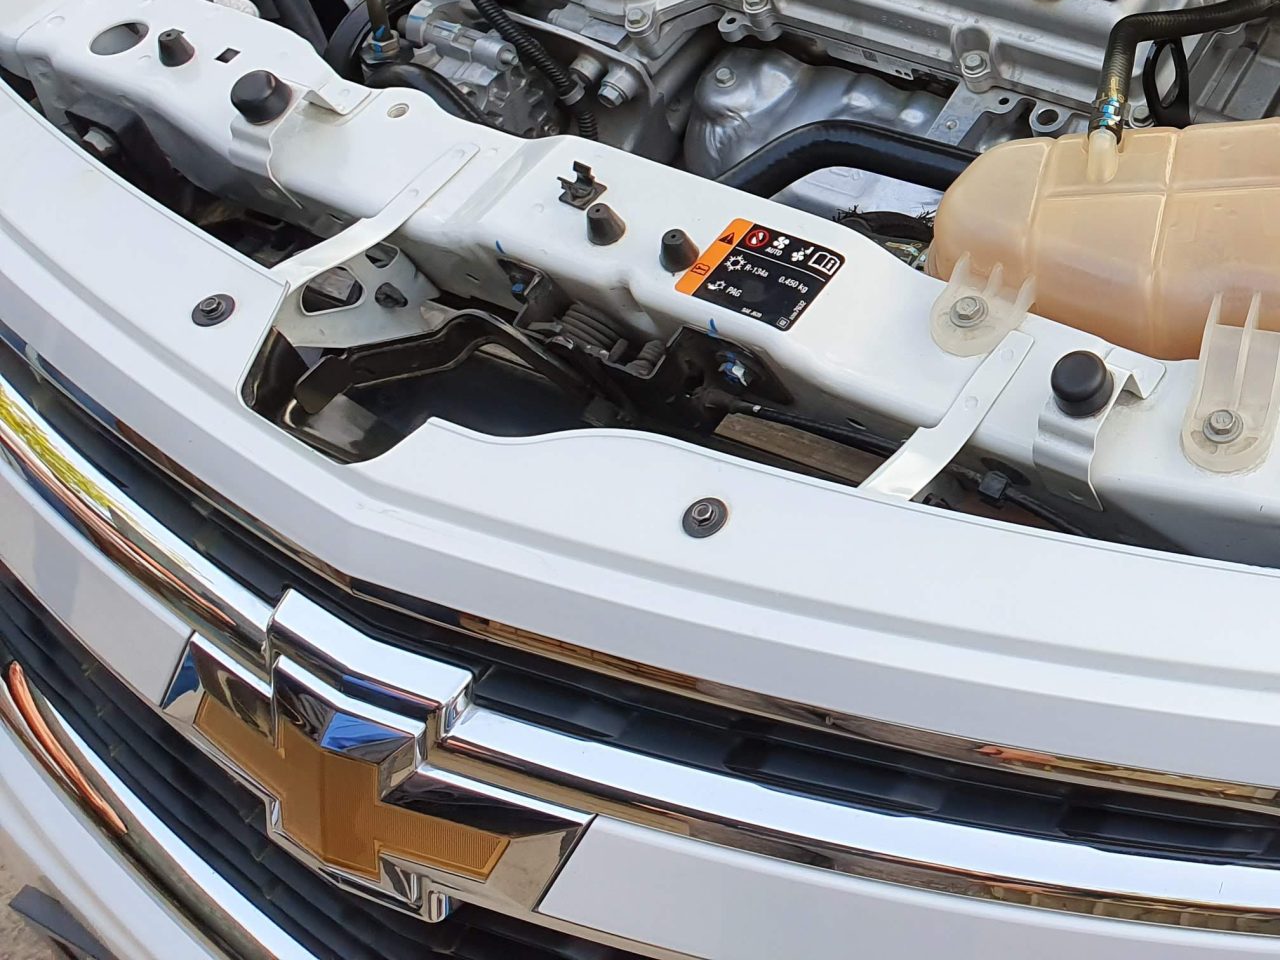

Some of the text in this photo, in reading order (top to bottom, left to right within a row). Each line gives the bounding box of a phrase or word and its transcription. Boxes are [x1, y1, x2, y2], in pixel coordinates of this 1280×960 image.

[765, 247, 783, 257] AUTO
[744, 264, 809, 295] R-134a 0.450 kg
[725, 286, 743, 298] PAG
